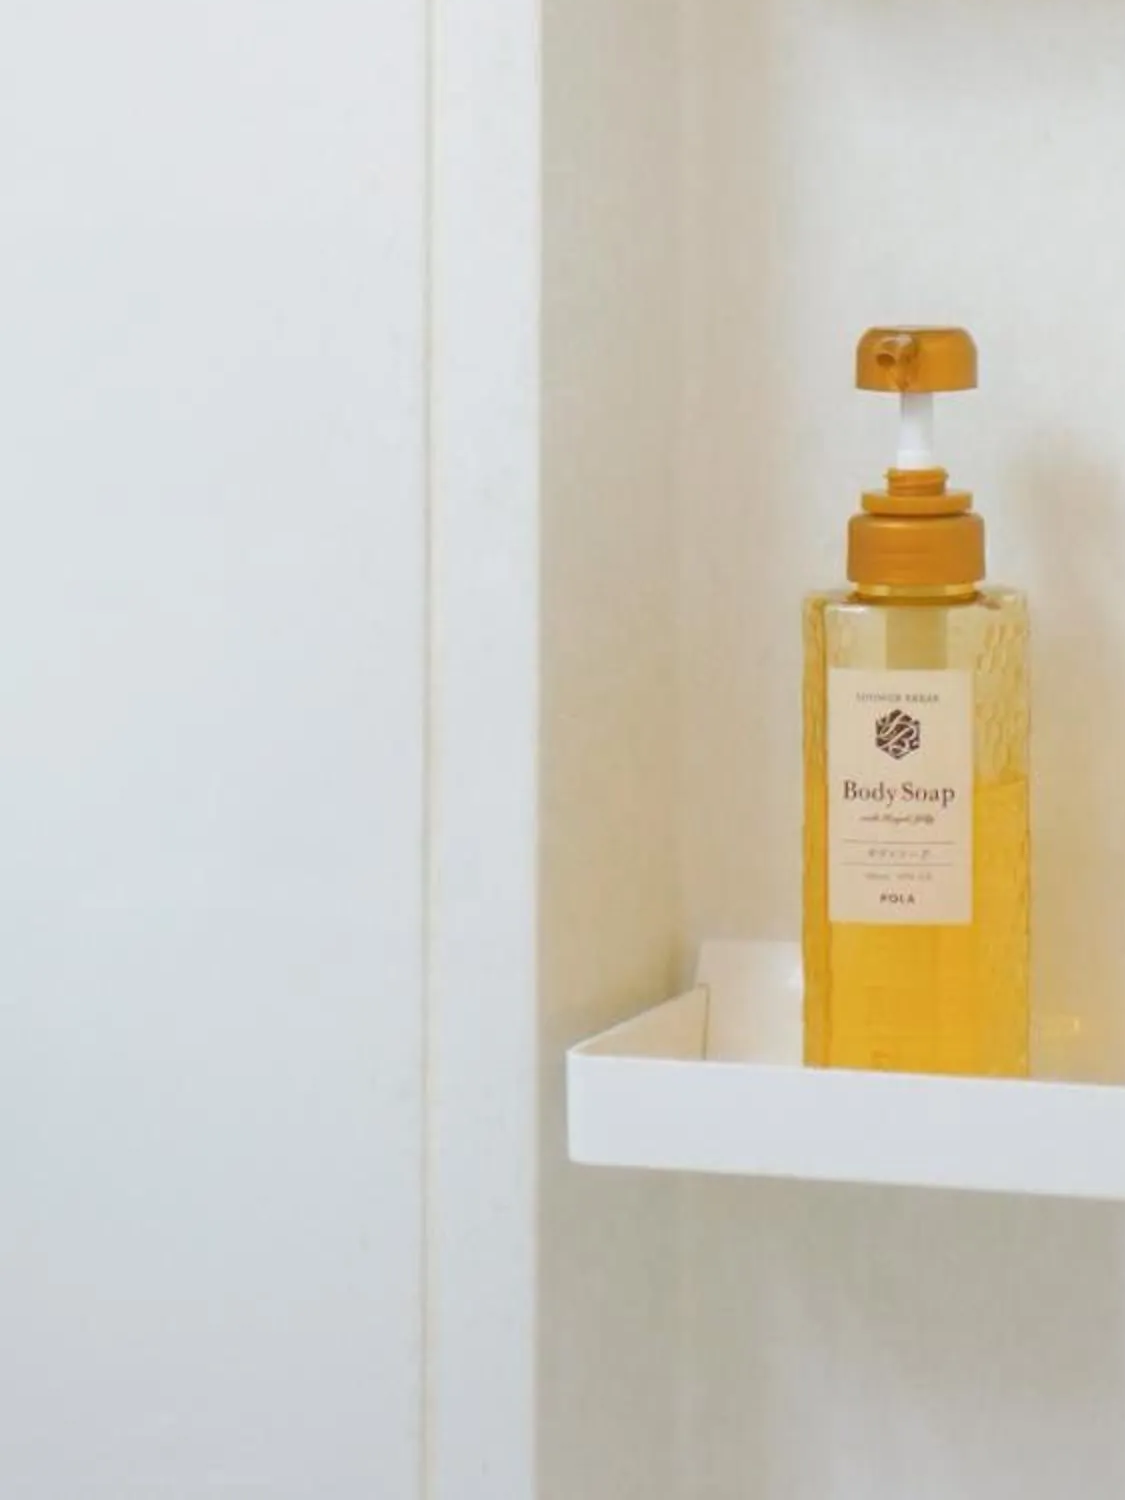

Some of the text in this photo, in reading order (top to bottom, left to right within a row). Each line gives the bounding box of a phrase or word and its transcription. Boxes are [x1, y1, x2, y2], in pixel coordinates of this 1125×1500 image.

[843, 780, 956, 808] Body Soap
[879, 893, 916, 904] POLA
